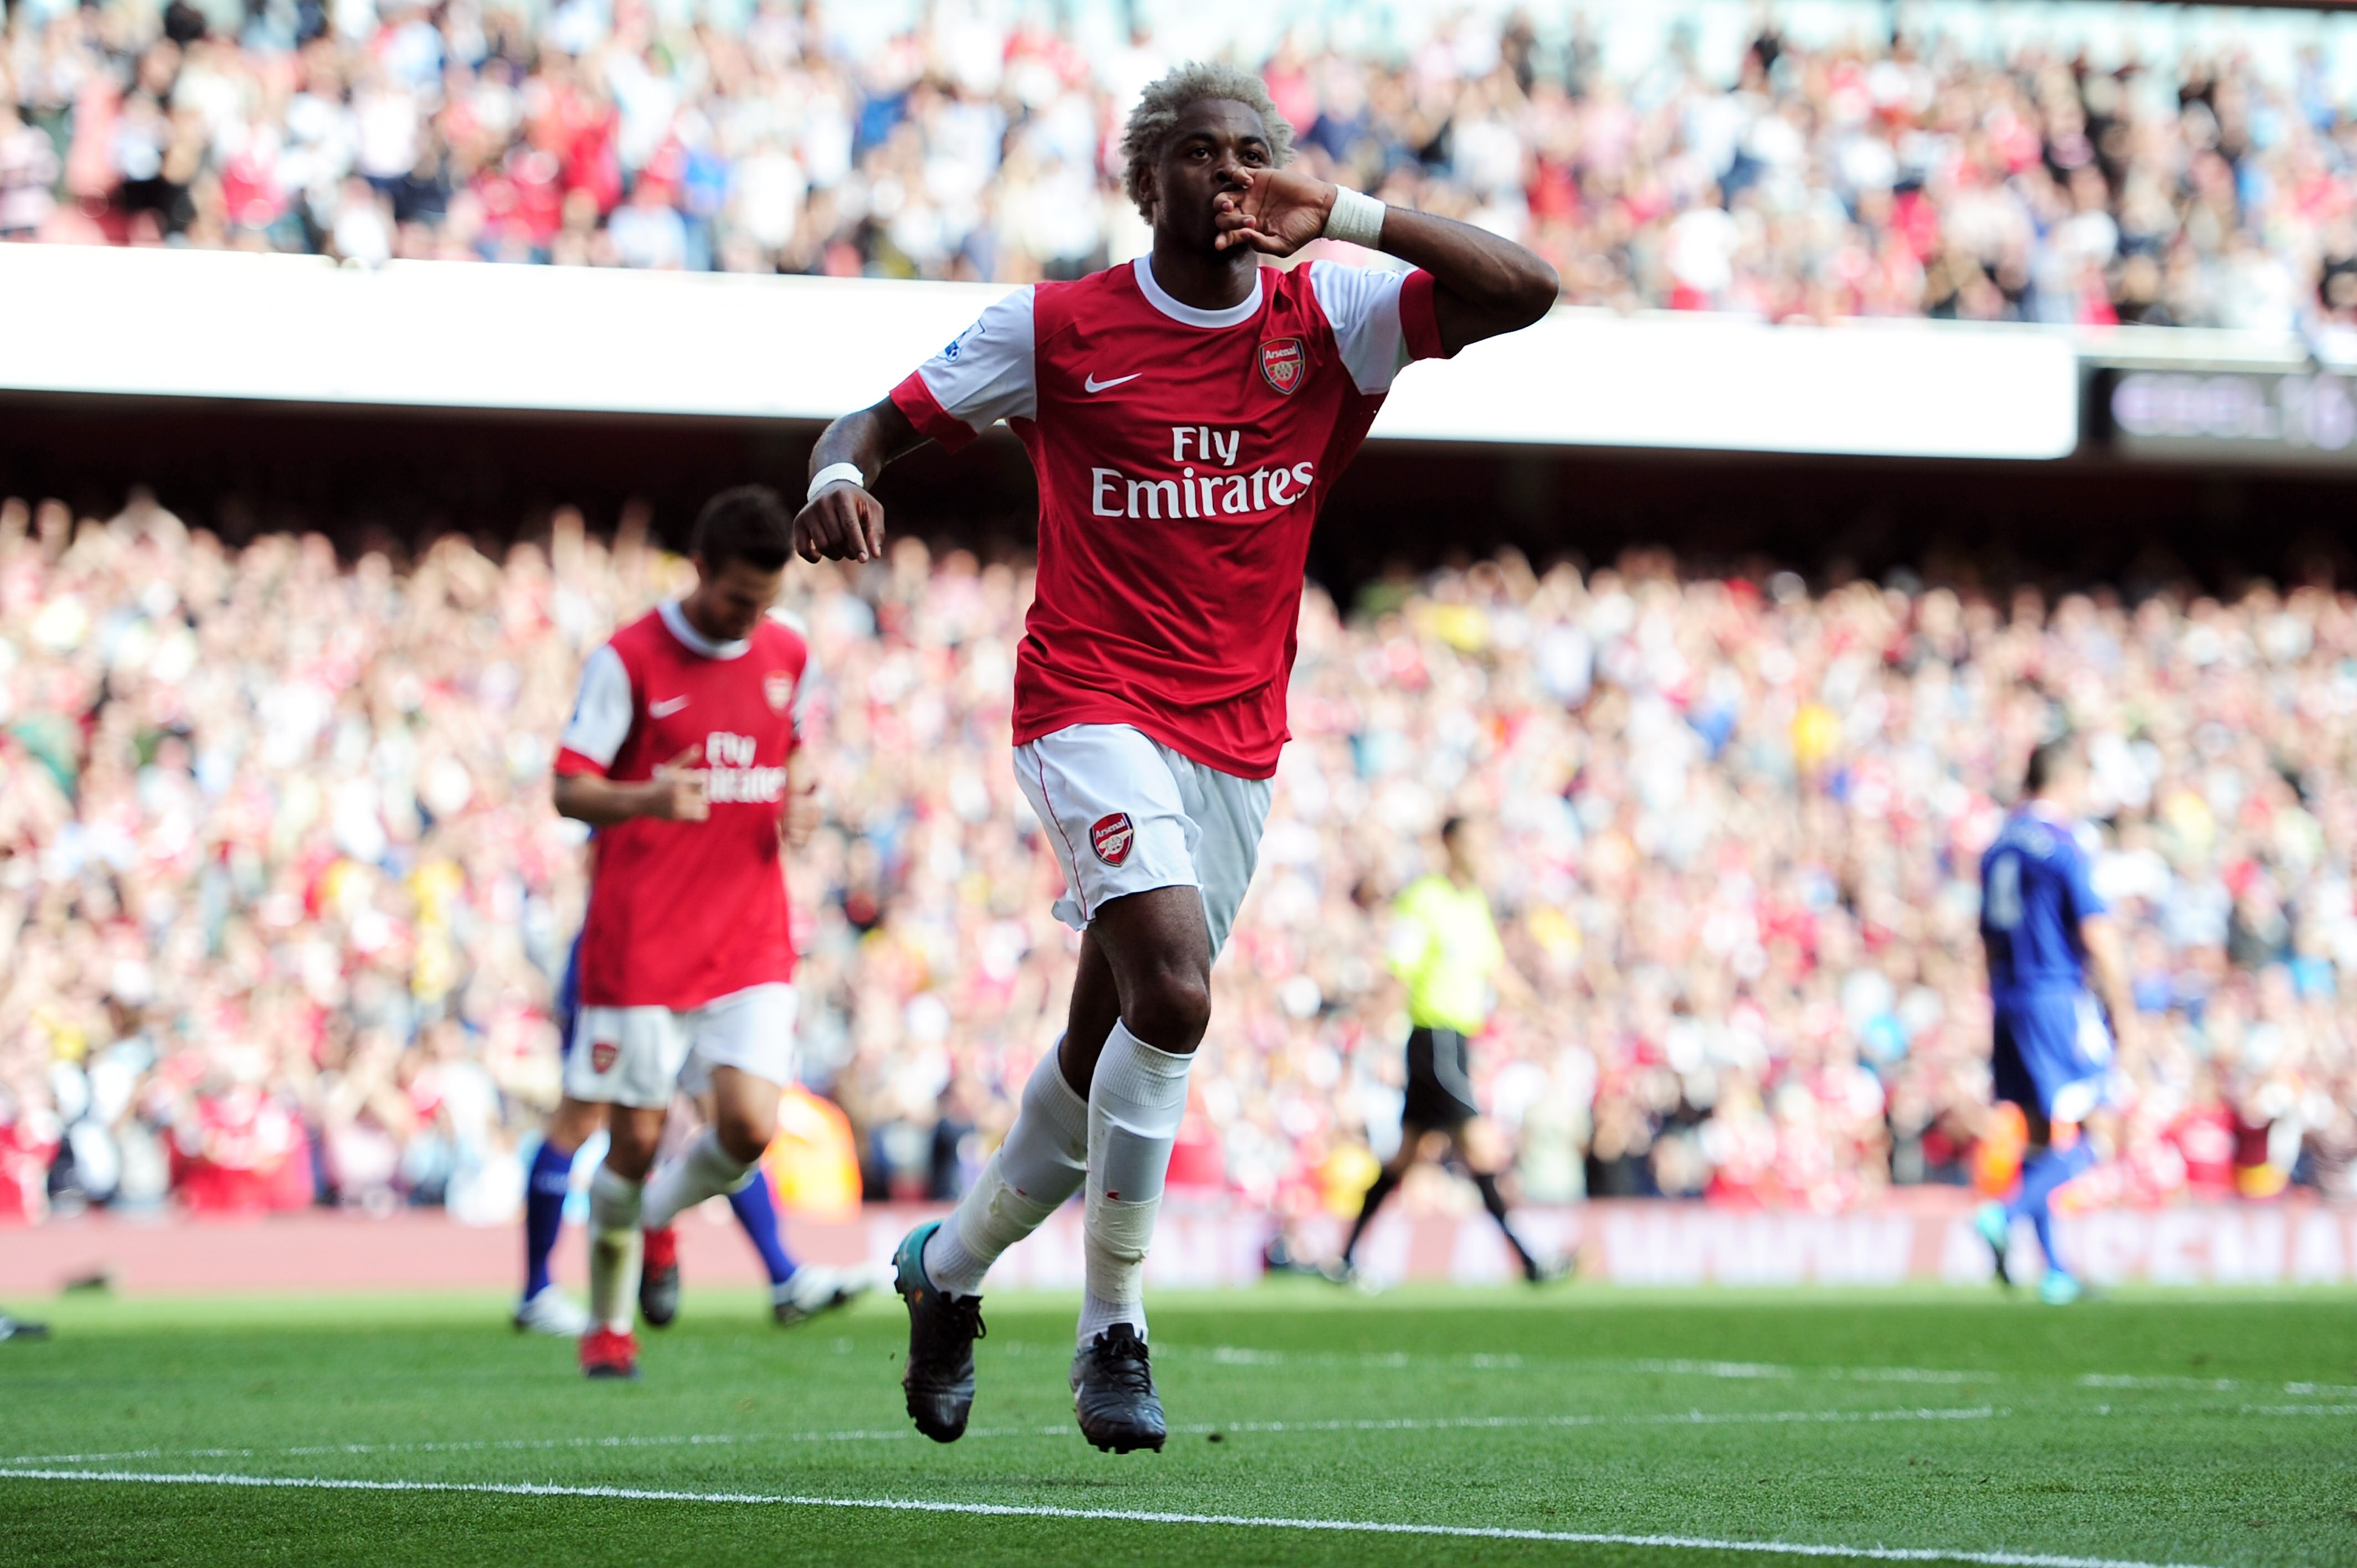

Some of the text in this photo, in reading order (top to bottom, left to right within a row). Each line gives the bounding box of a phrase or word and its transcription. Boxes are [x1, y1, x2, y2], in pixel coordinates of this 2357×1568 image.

[1265, 345, 1297, 359] Arsenal
[1171, 426, 1240, 466] Fly
[1091, 461, 1314, 519] Emirates
[1095, 818, 1126, 839] Arsenal
